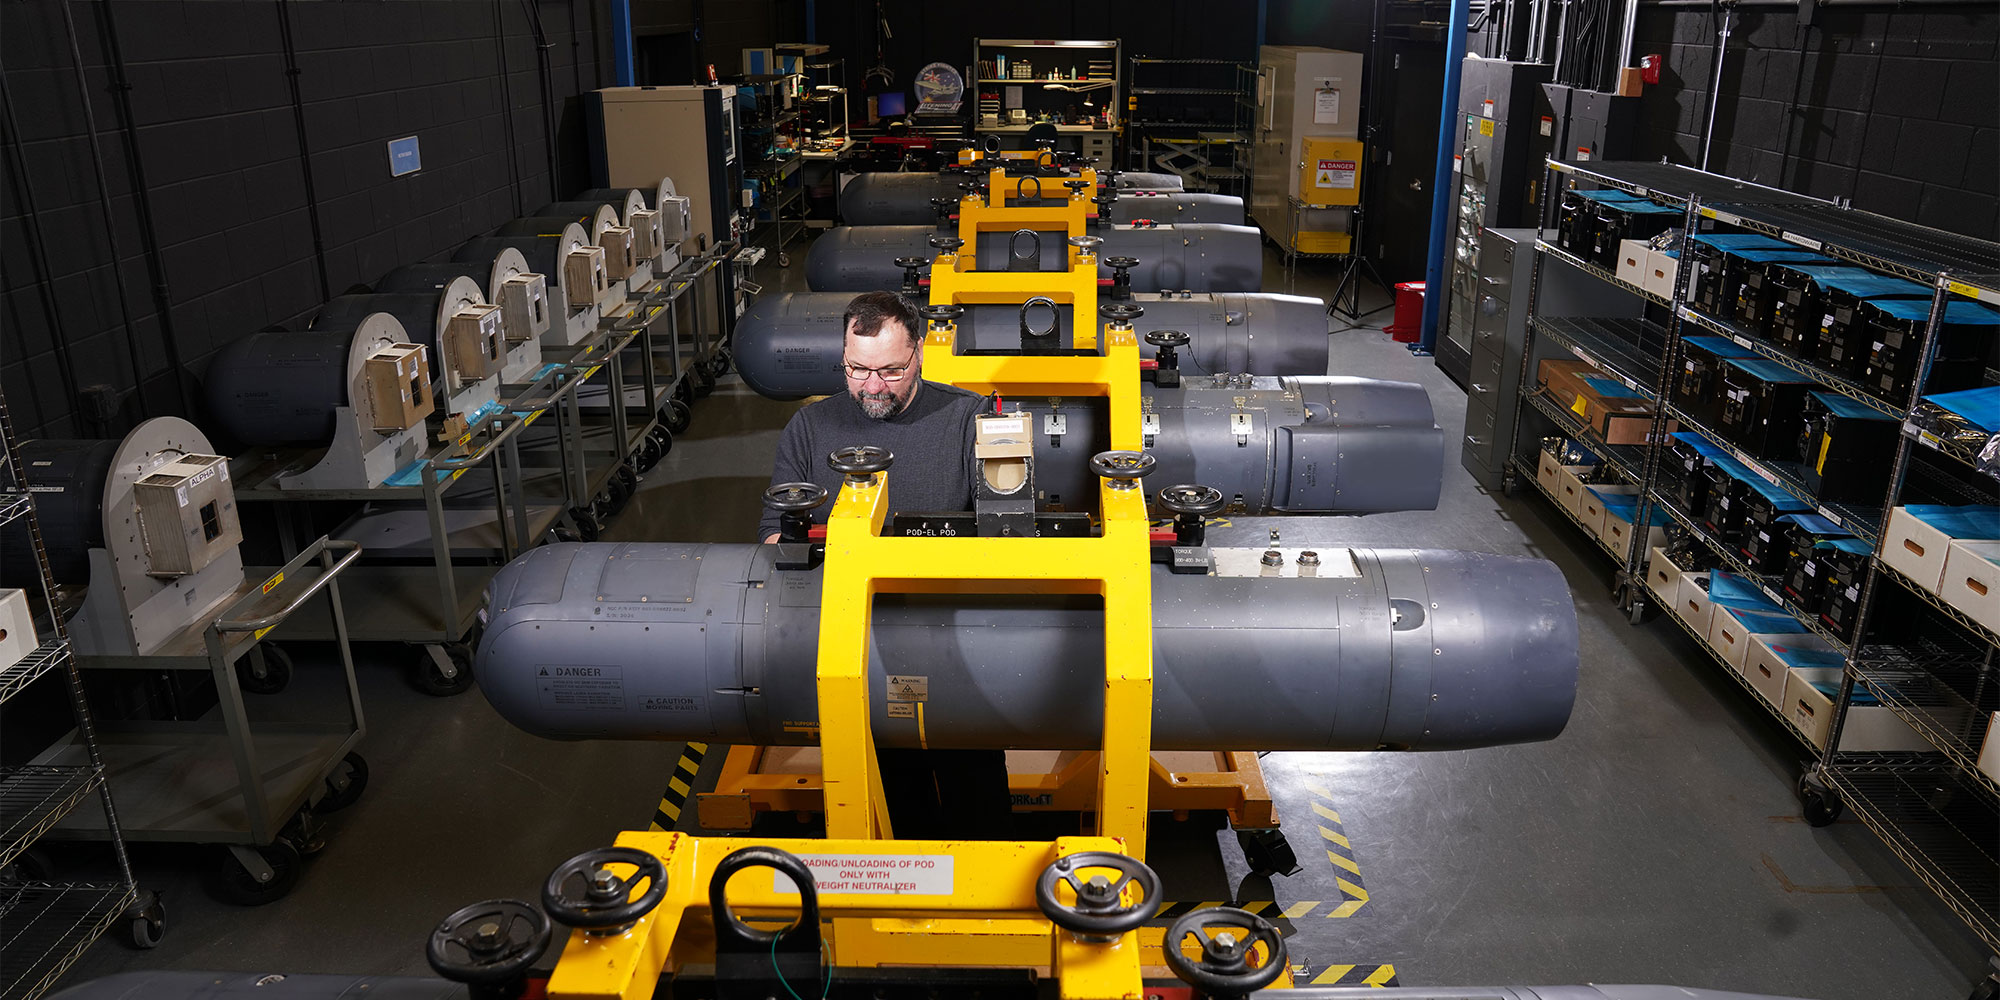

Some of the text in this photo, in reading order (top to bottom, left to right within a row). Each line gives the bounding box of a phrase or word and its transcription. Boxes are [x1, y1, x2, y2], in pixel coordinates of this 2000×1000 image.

[1327, 162, 1355, 170] DANGER
[191, 468, 214, 487] ALPHA
[906, 528, 937, 537] POD-EL
[940, 529, 956, 537] POD
[556, 667, 601, 677] DANGER
[656, 697, 694, 705] CAUTION
[801, 858, 935, 869] OADING/UNLOADING OF POD
[839, 870, 890, 879] ONLY WITH
[852, 882, 917, 891] NEUTRALIZER
